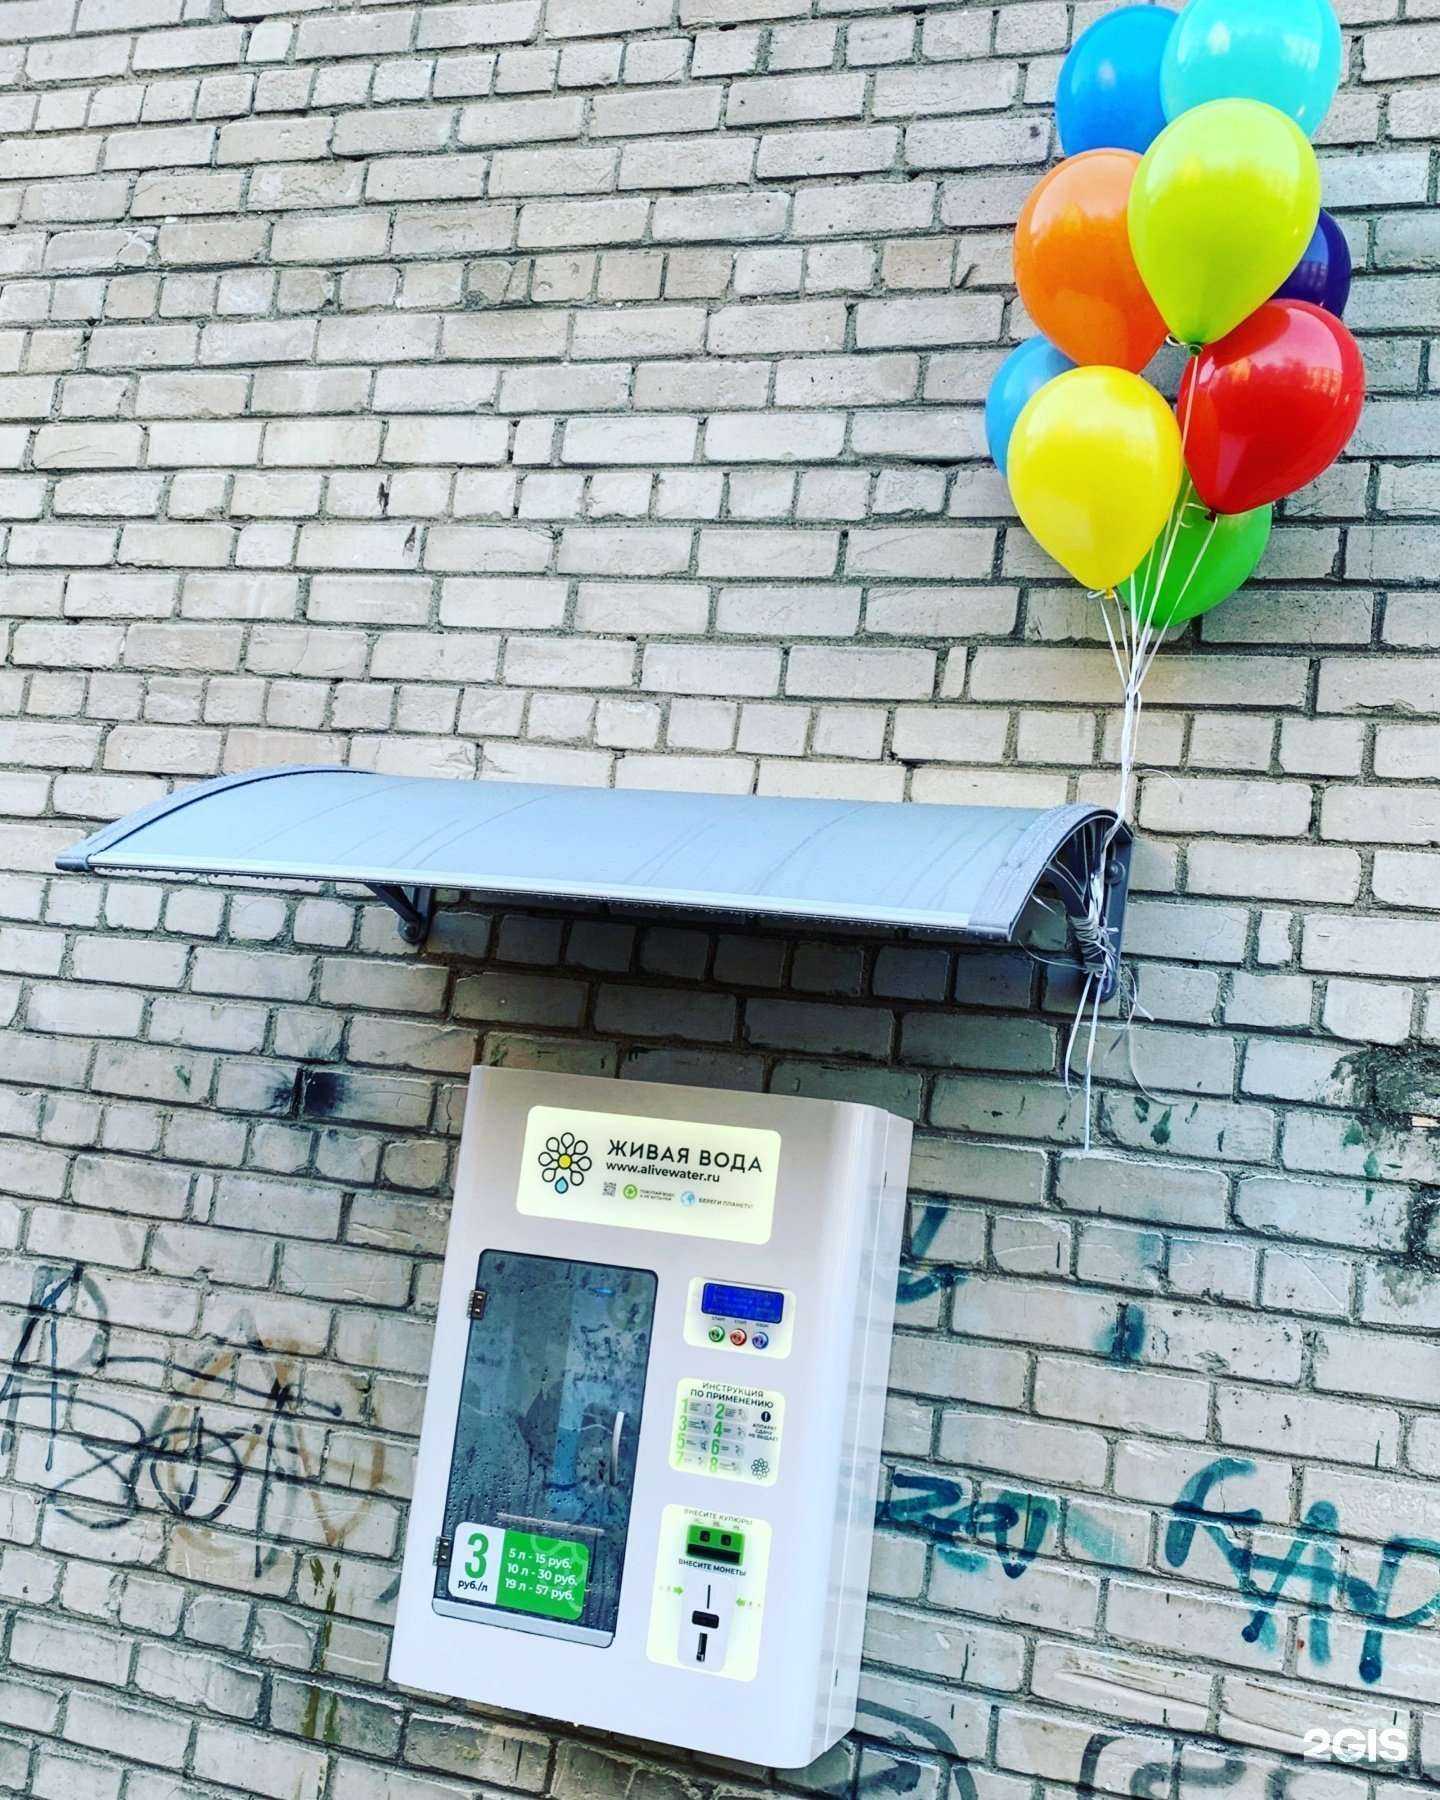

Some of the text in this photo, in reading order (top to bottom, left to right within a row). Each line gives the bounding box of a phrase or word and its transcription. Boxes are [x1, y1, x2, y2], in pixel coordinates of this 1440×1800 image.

[607, 1139, 762, 1173] ЖИВАЯ ВОДА
[606, 1161, 720, 1183] www.alivewater.ru
[690, 1389, 704, 1398] ПО
[706, 1391, 774, 1409] ПРИМЕНЕНИЮ
[702, 1382, 764, 1398] ИНСТРУКЦИЯ
[715, 1403, 725, 1419] 2
[713, 1421, 723, 1437] 4
[711, 1438, 720, 1455] 6
[465, 1532, 489, 1580] 3
[508, 1547, 517, 1559] 5
[535, 1552, 546, 1564] 15
[548, 1556, 572, 1569] руб.
[507, 1563, 519, 1574] 10
[537, 1568, 552, 1581] 30
[554, 1574, 578, 1586] руб.
[678, 1558, 747, 1577] ВНЕСИТЕ МОНЕТЫ
[457, 1579, 488, 1592] руб./л
[505, 1578, 517, 1589] 19
[535, 1583, 549, 1596] 57
[551, 1588, 575, 1601] руб.
